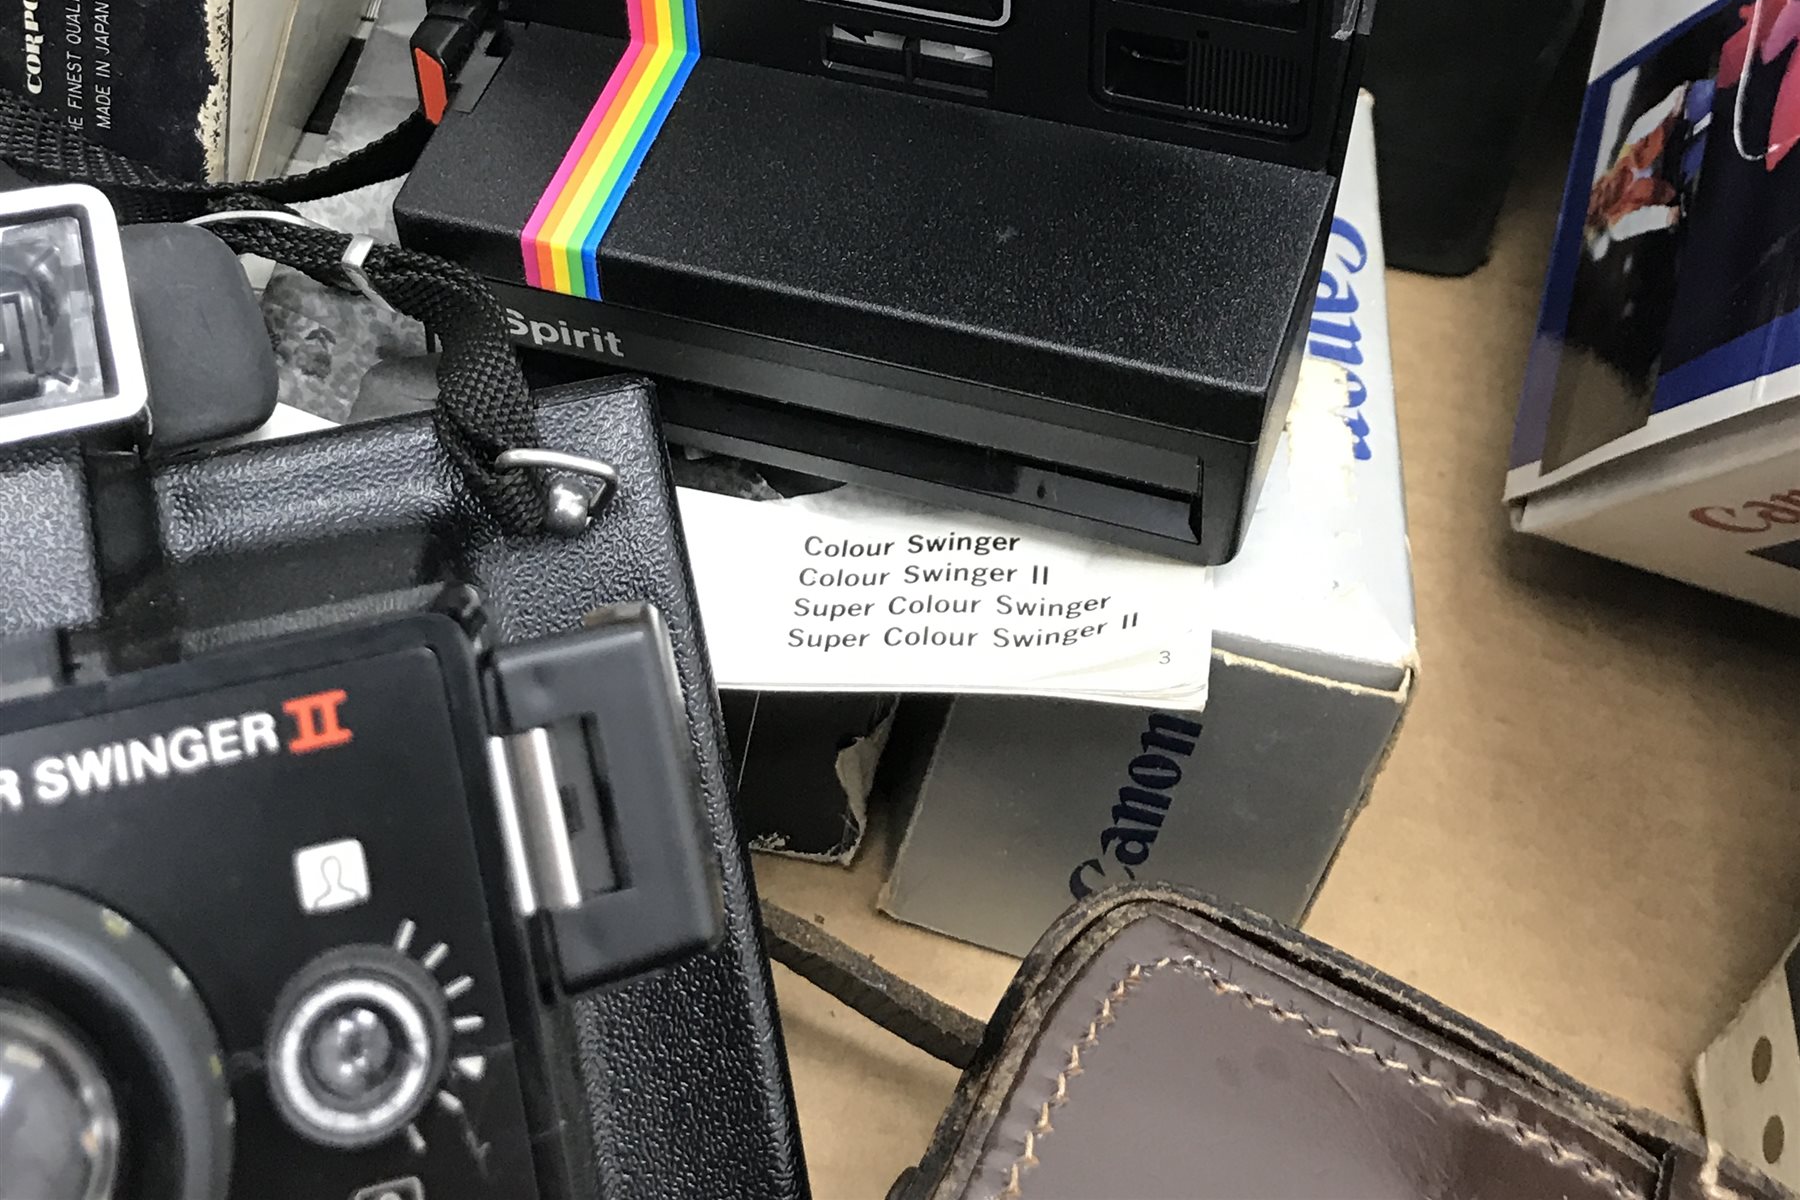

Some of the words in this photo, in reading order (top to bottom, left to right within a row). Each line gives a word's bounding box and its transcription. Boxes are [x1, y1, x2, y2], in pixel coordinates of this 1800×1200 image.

[95, 1, 111, 55] JAPAN
[66, 51, 83, 110] FINEST
[95, 60, 111, 78] IN
[95, 84, 111, 129] MADE
[505, 307, 625, 358] Spirit
[804, 535, 895, 558] Colour
[907, 530, 1021, 556] Swinger
[798, 567, 891, 588] Colour
[903, 562, 1018, 588] Swinger
[1031, 565, 1050, 585] II
[793, 597, 875, 622] Super
[888, 594, 981, 615] Colour
[996, 594, 1112, 620] Swinger
[787, 627, 870, 653] Super
[883, 625, 979, 648] Colour
[993, 619, 1108, 648] Swinger
[1121, 612, 1139, 630] II
[1158, 650, 1172, 666] 3
[33, 711, 281, 803] SWINGER
[281, 688, 353, 755] II
